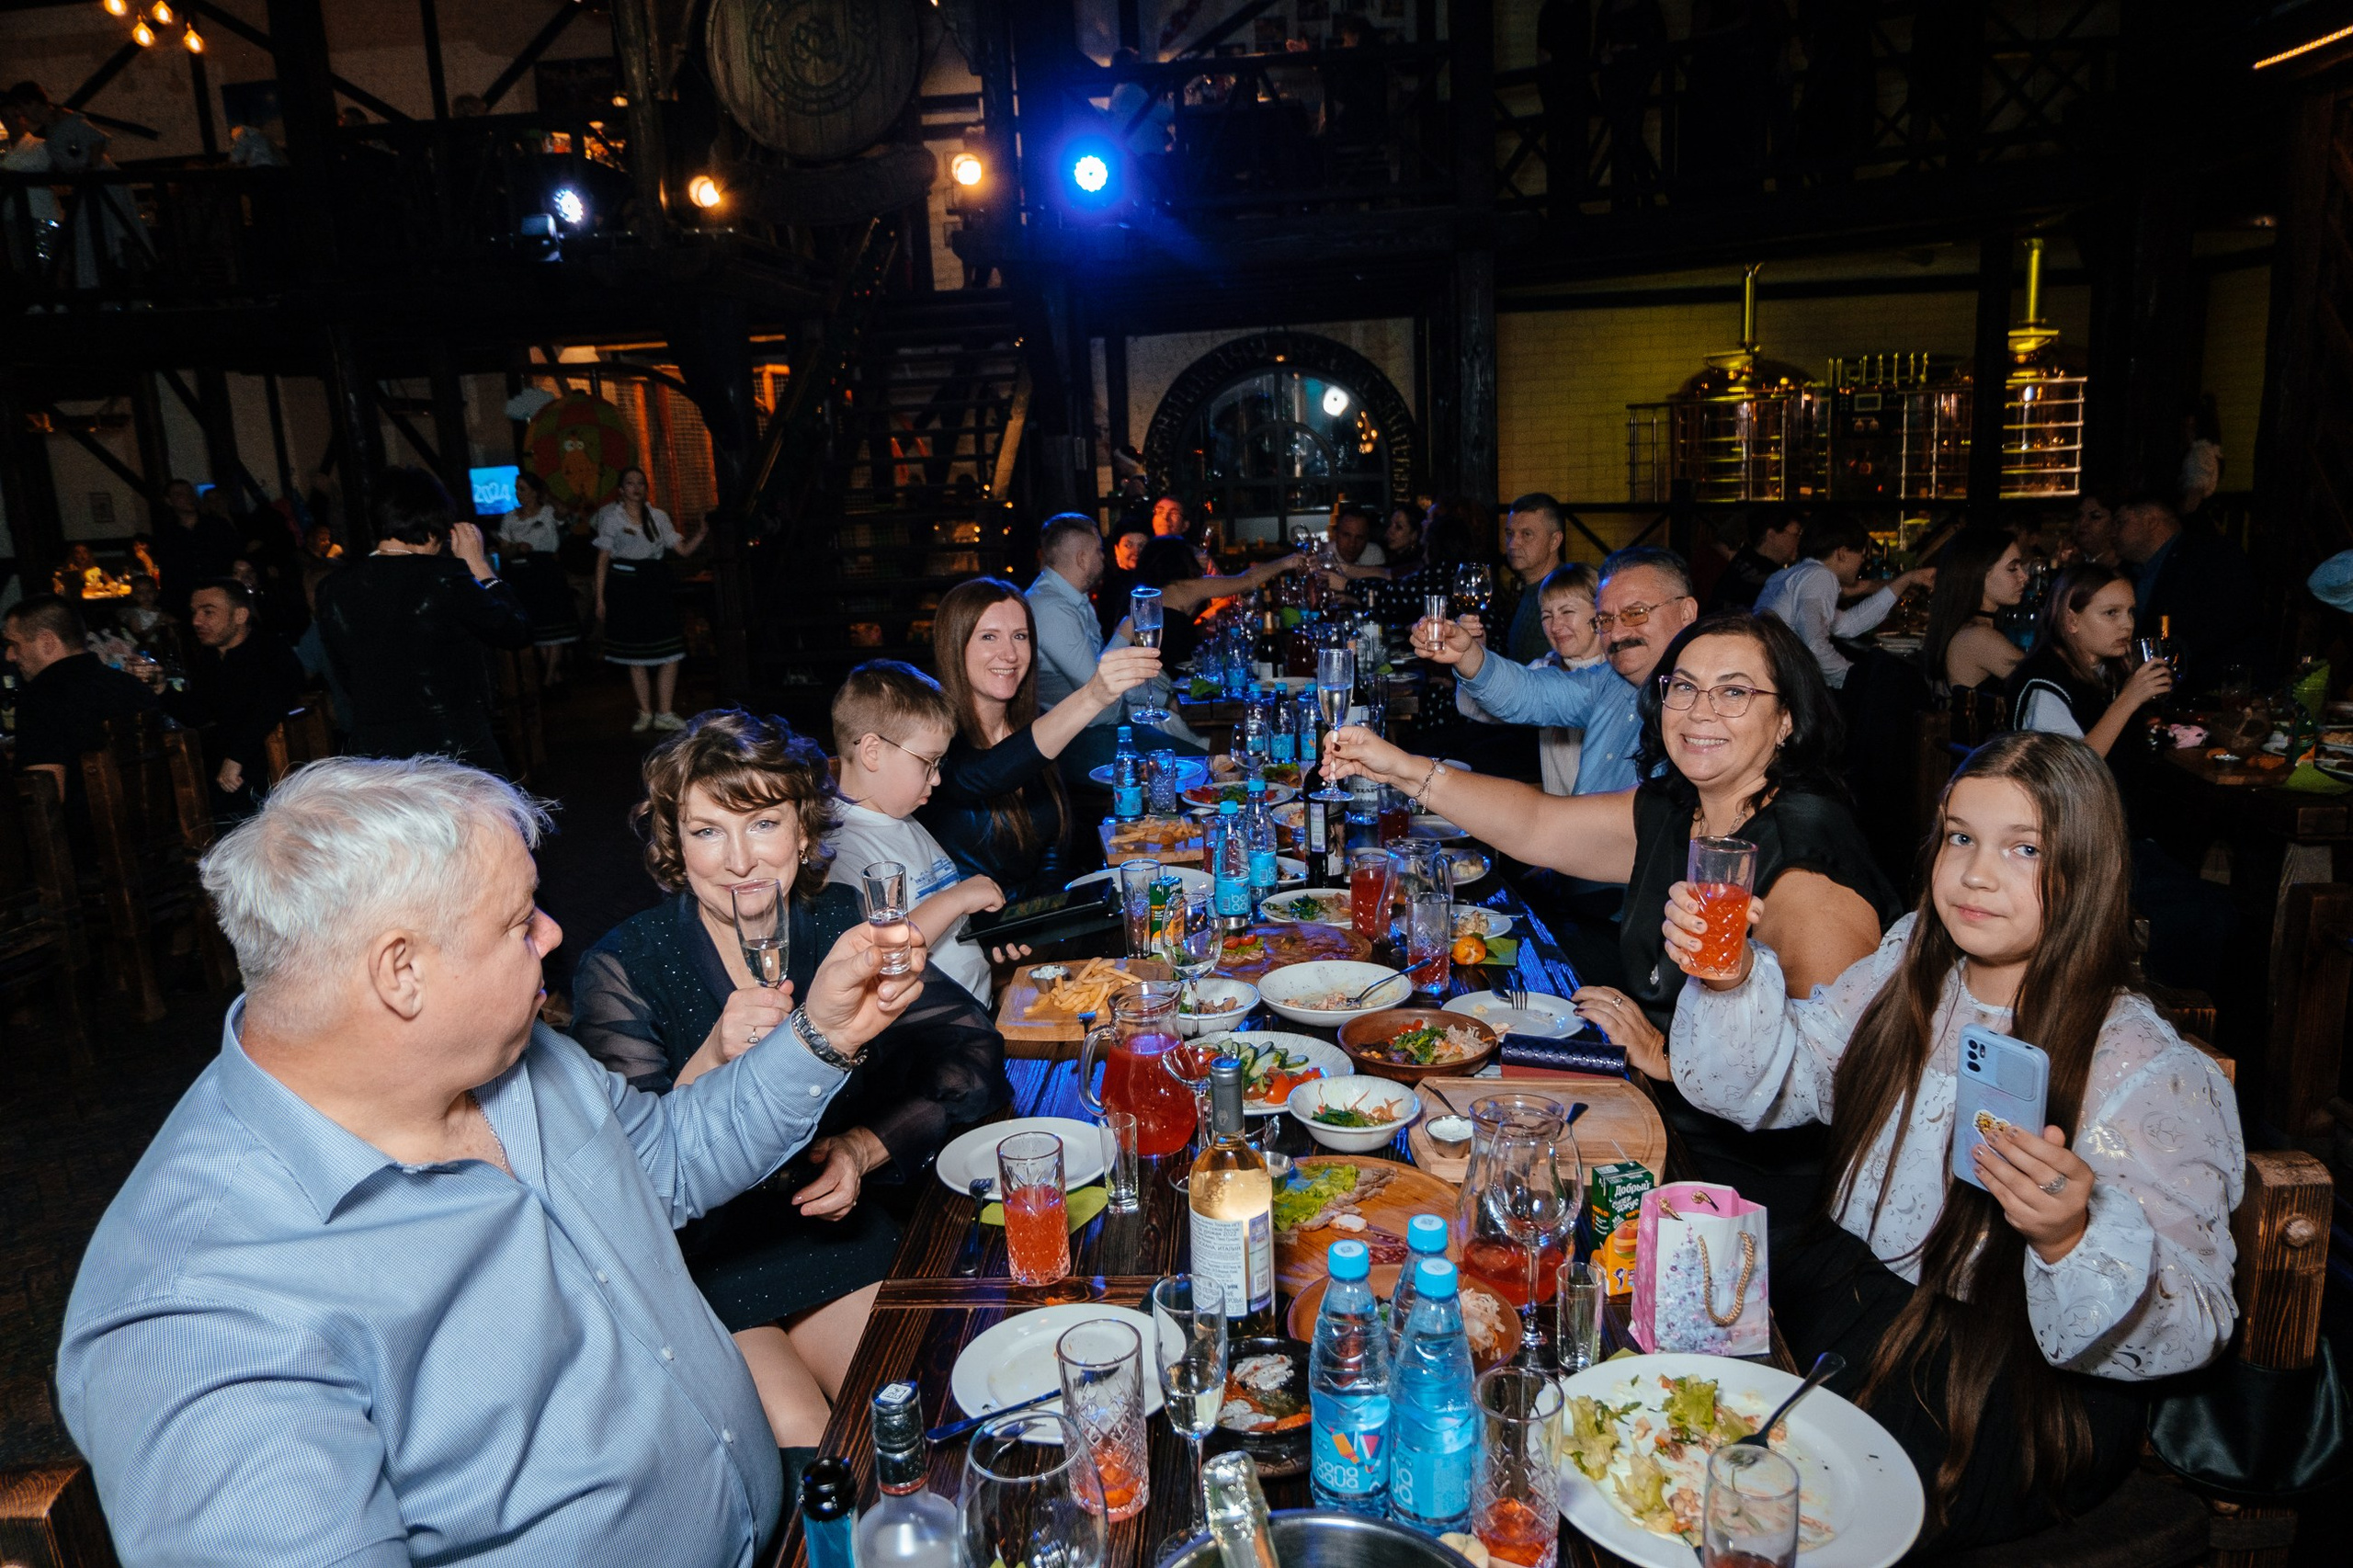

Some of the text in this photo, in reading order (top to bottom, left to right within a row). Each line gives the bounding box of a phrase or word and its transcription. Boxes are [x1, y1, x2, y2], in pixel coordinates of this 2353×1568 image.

[473, 482, 511, 504] 2024
[1614, 1180, 1650, 1198] Добрый
[1316, 1452, 1358, 1476] bona
[1317, 1467, 1358, 1489] aqua
